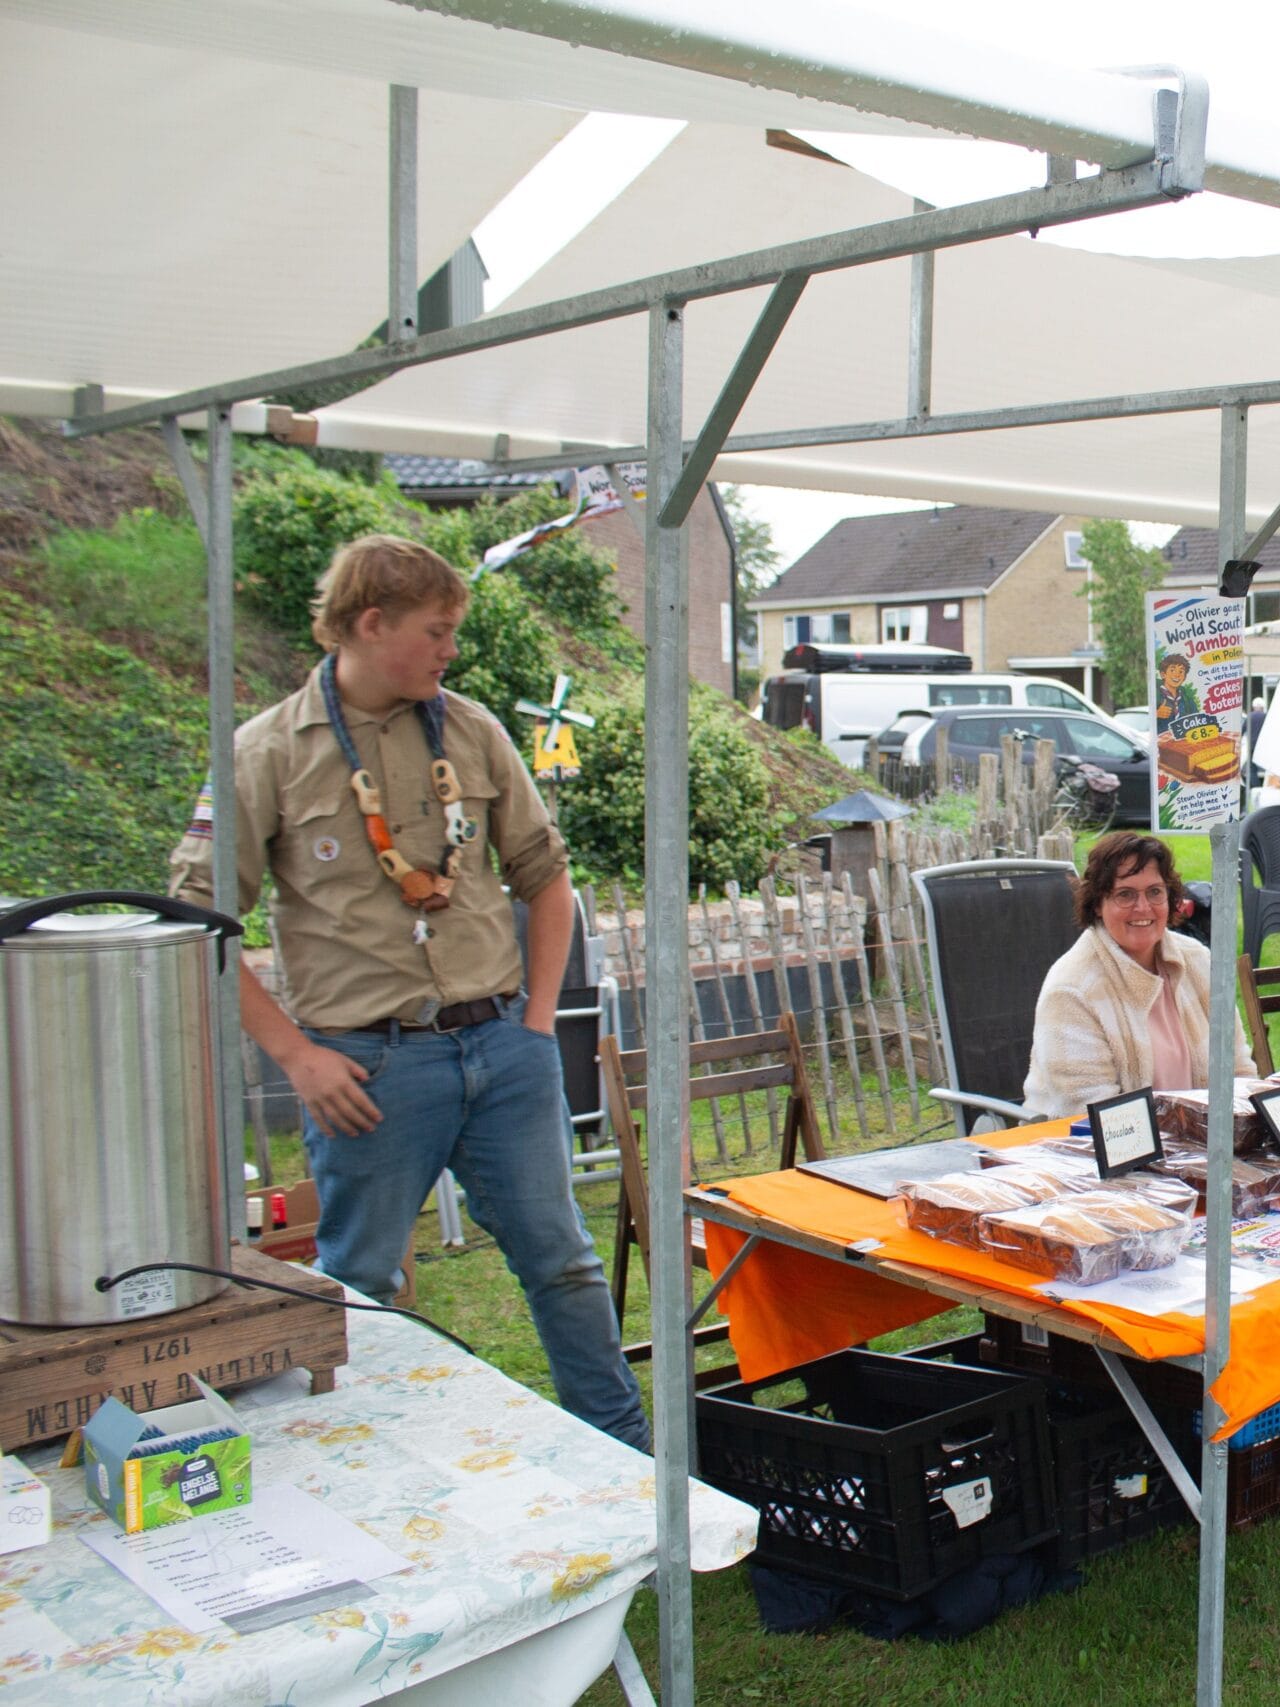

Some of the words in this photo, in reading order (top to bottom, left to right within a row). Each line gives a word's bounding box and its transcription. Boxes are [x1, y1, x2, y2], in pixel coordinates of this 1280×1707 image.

[1185, 606, 1221, 622] Olivier
[1165, 621, 1205, 645] World
[1212, 652, 1221, 661] in
[1182, 716, 1208, 730] Cake
[143, 1336, 192, 1365] 1971
[181, 1470, 217, 1492] ENGELSE
